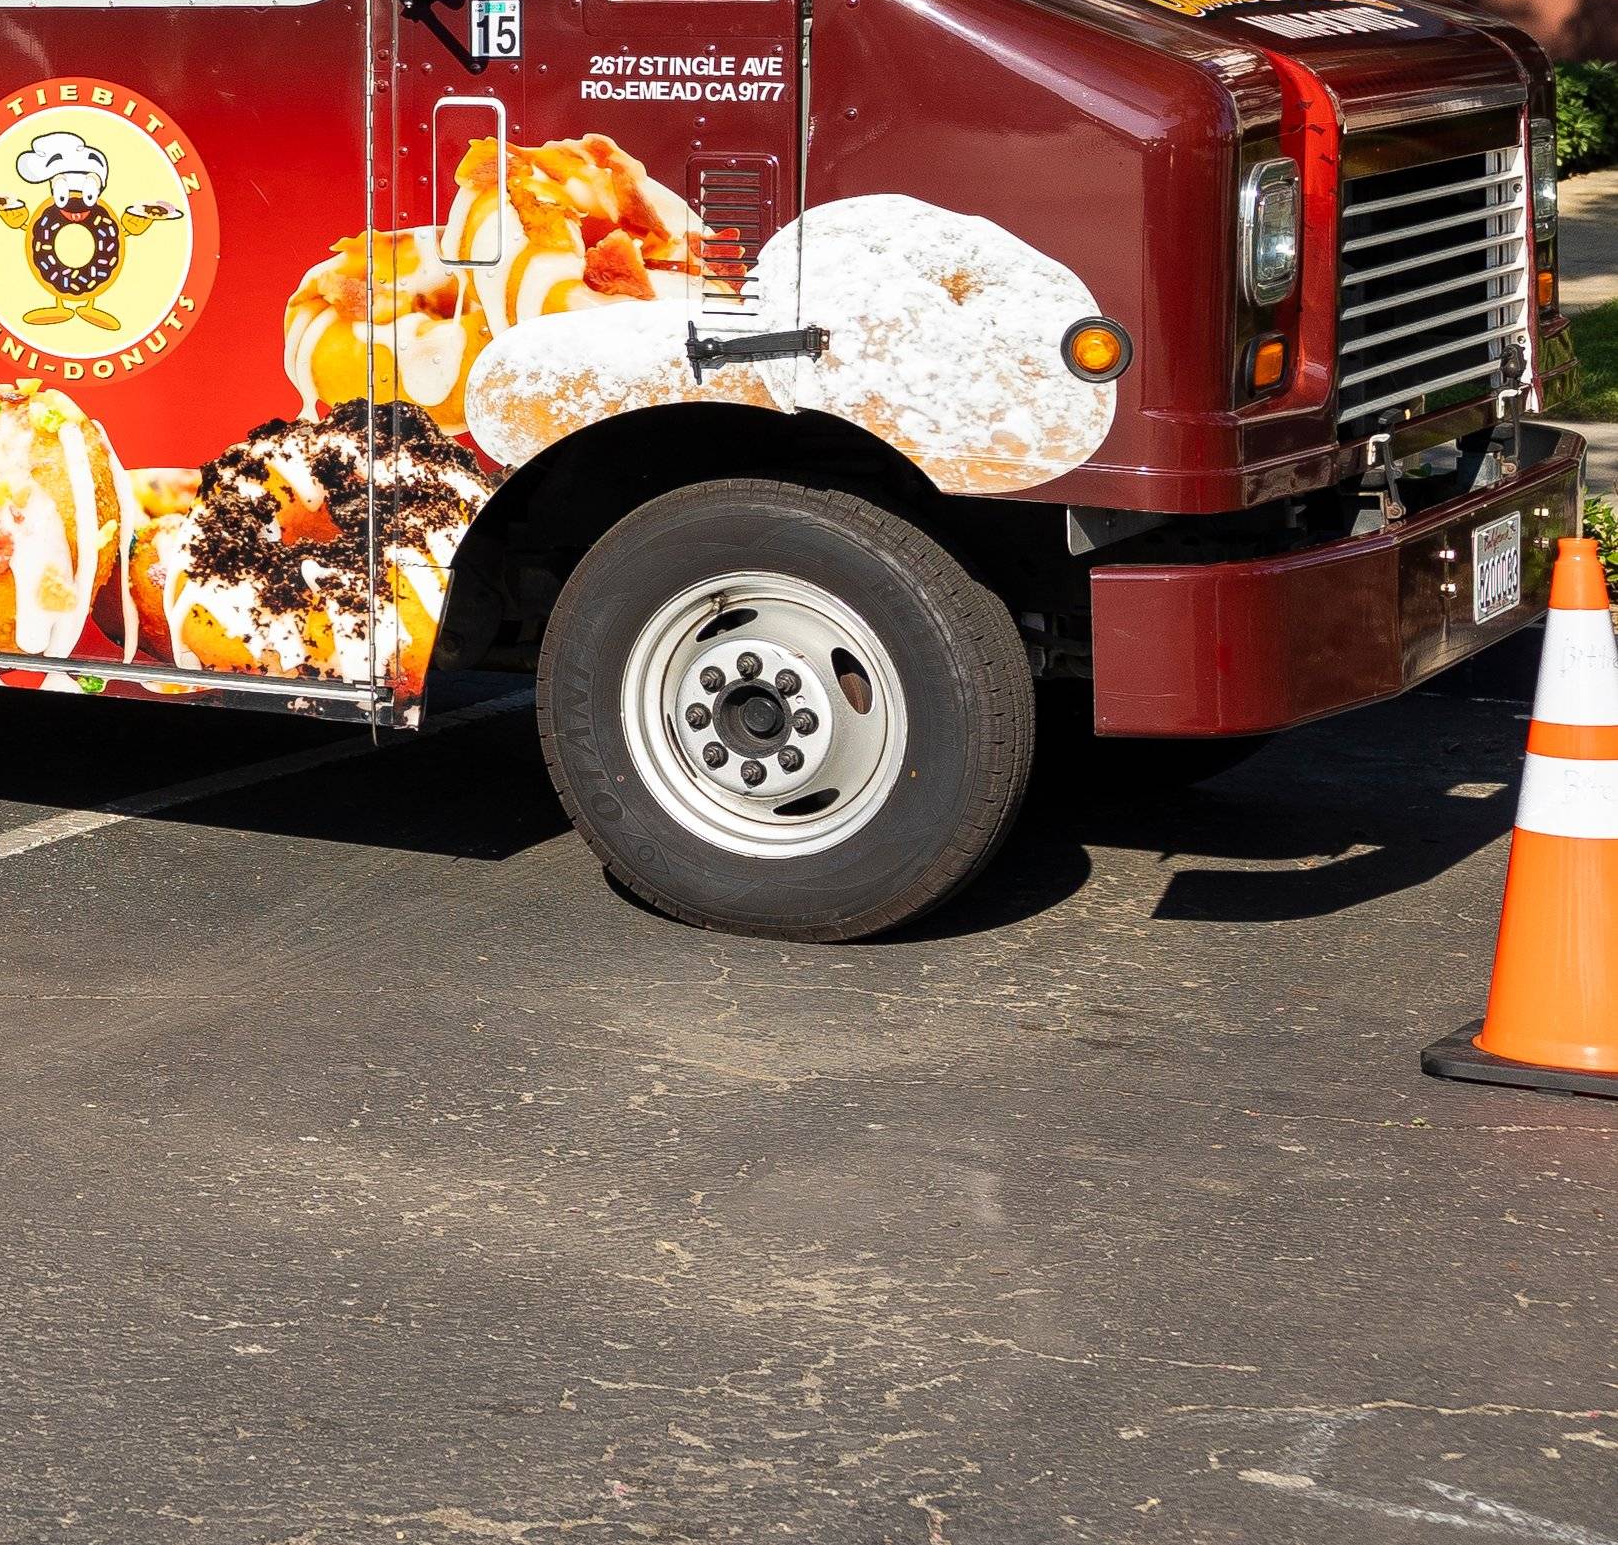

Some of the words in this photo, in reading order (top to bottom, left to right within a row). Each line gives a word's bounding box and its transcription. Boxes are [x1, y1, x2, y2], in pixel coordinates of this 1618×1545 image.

[476, 14, 516, 55] 15
[589, 56, 635, 76] 2617
[639, 56, 735, 76] STINGLE
[740, 56, 783, 77] AVE
[705, 81, 738, 101] CA
[738, 81, 785, 102] 9177
